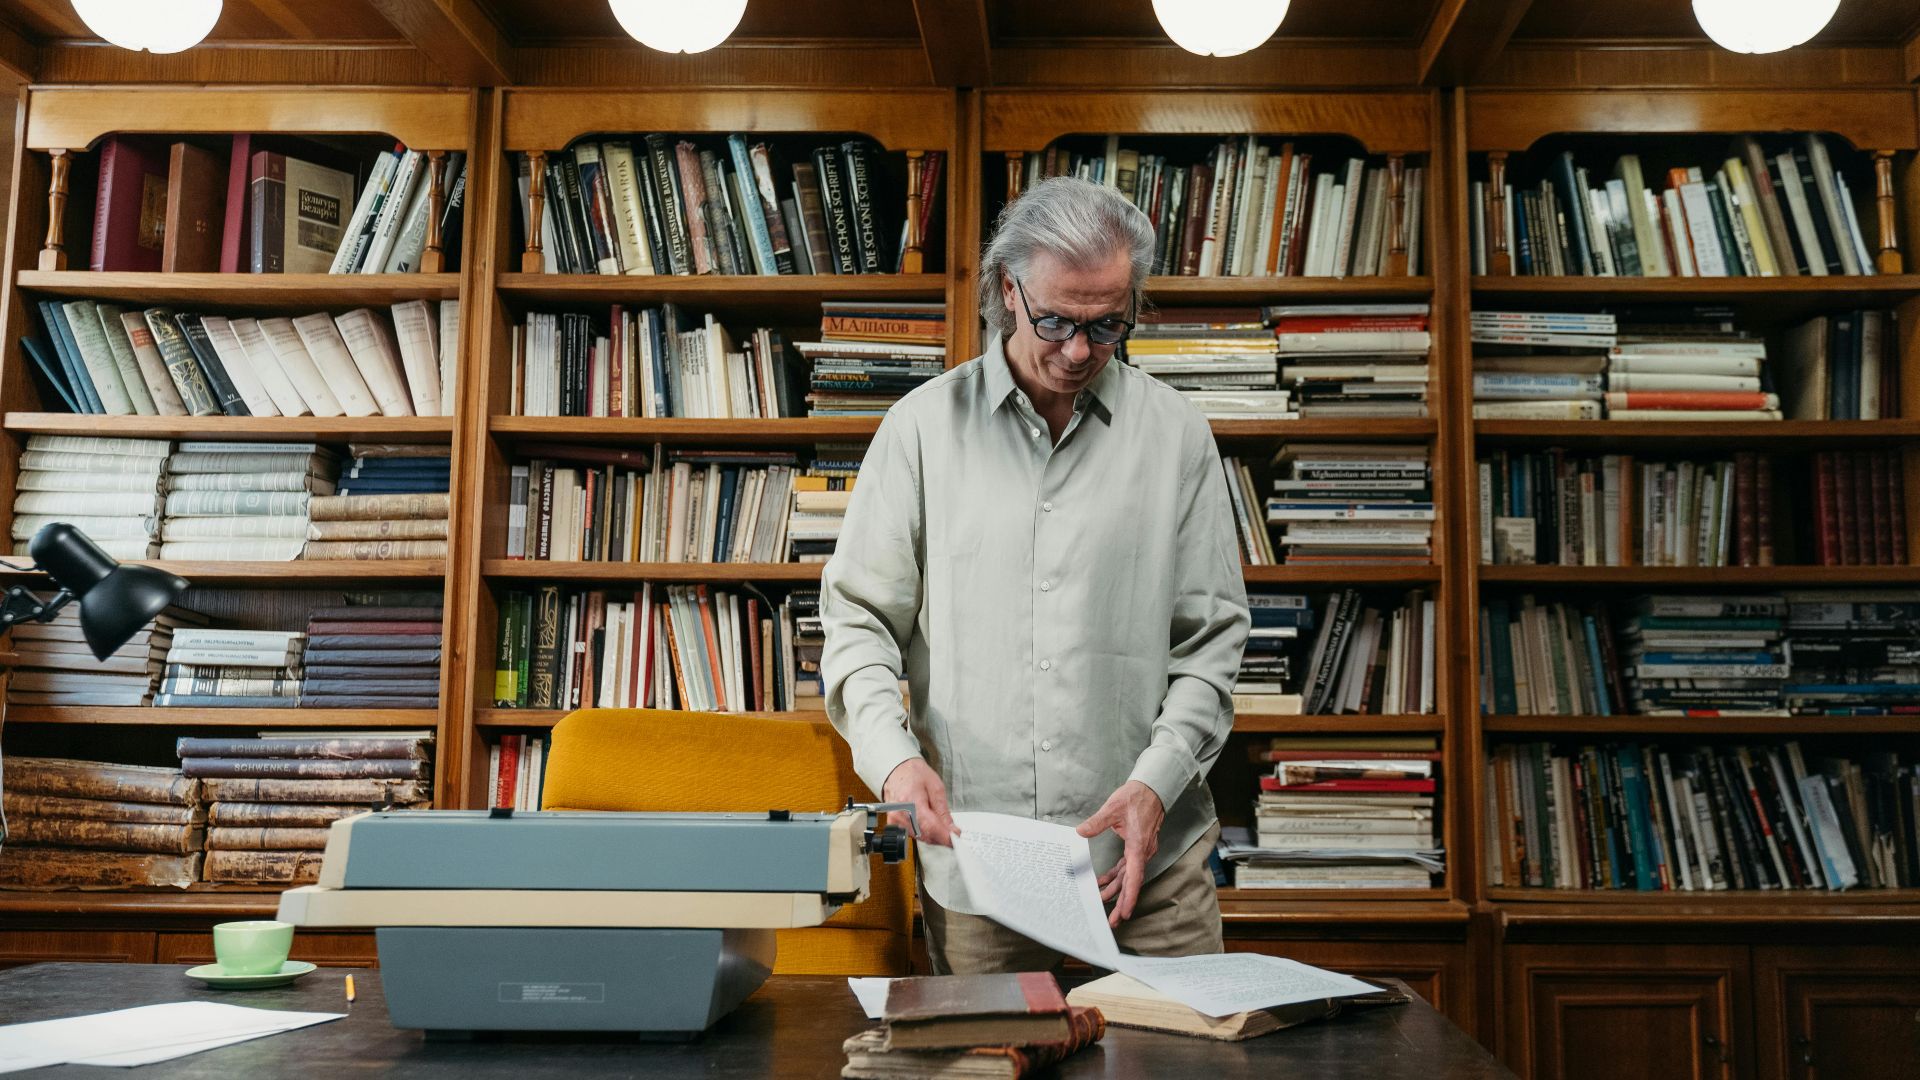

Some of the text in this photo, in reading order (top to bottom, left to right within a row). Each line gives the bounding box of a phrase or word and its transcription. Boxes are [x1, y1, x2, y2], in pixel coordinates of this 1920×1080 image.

[616, 159, 632, 202] BAROK
[655, 148, 682, 259] ALTRUSSISCHE BAUKUNST
[841, 253, 852, 272] DIE
[866, 249, 877, 268] DIE
[539, 467, 552, 557] ЗОДЧЕСТВО АПШЕРОНА
[501, 617, 511, 660] Steel Structures
